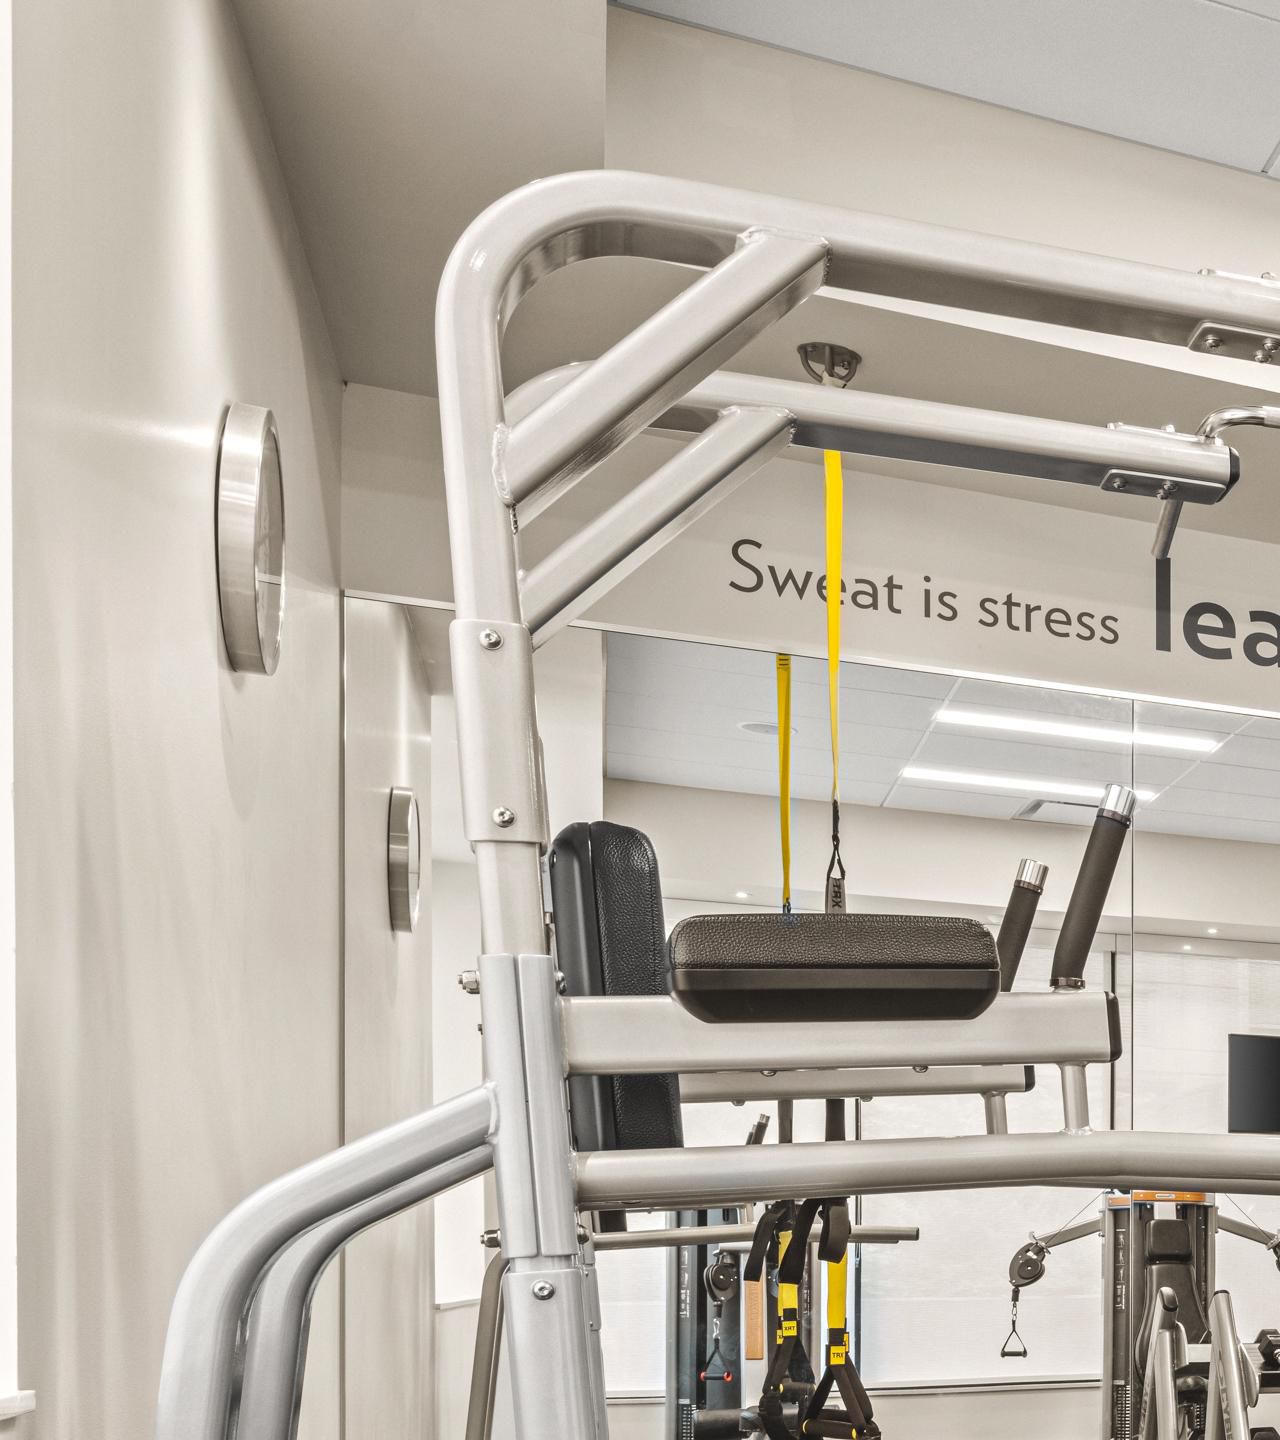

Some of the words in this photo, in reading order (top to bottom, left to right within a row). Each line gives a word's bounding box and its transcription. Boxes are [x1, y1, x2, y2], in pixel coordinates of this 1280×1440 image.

[729, 538, 903, 614] Sweat
[921, 575, 958, 622] is
[978, 592, 1120, 645] stress
